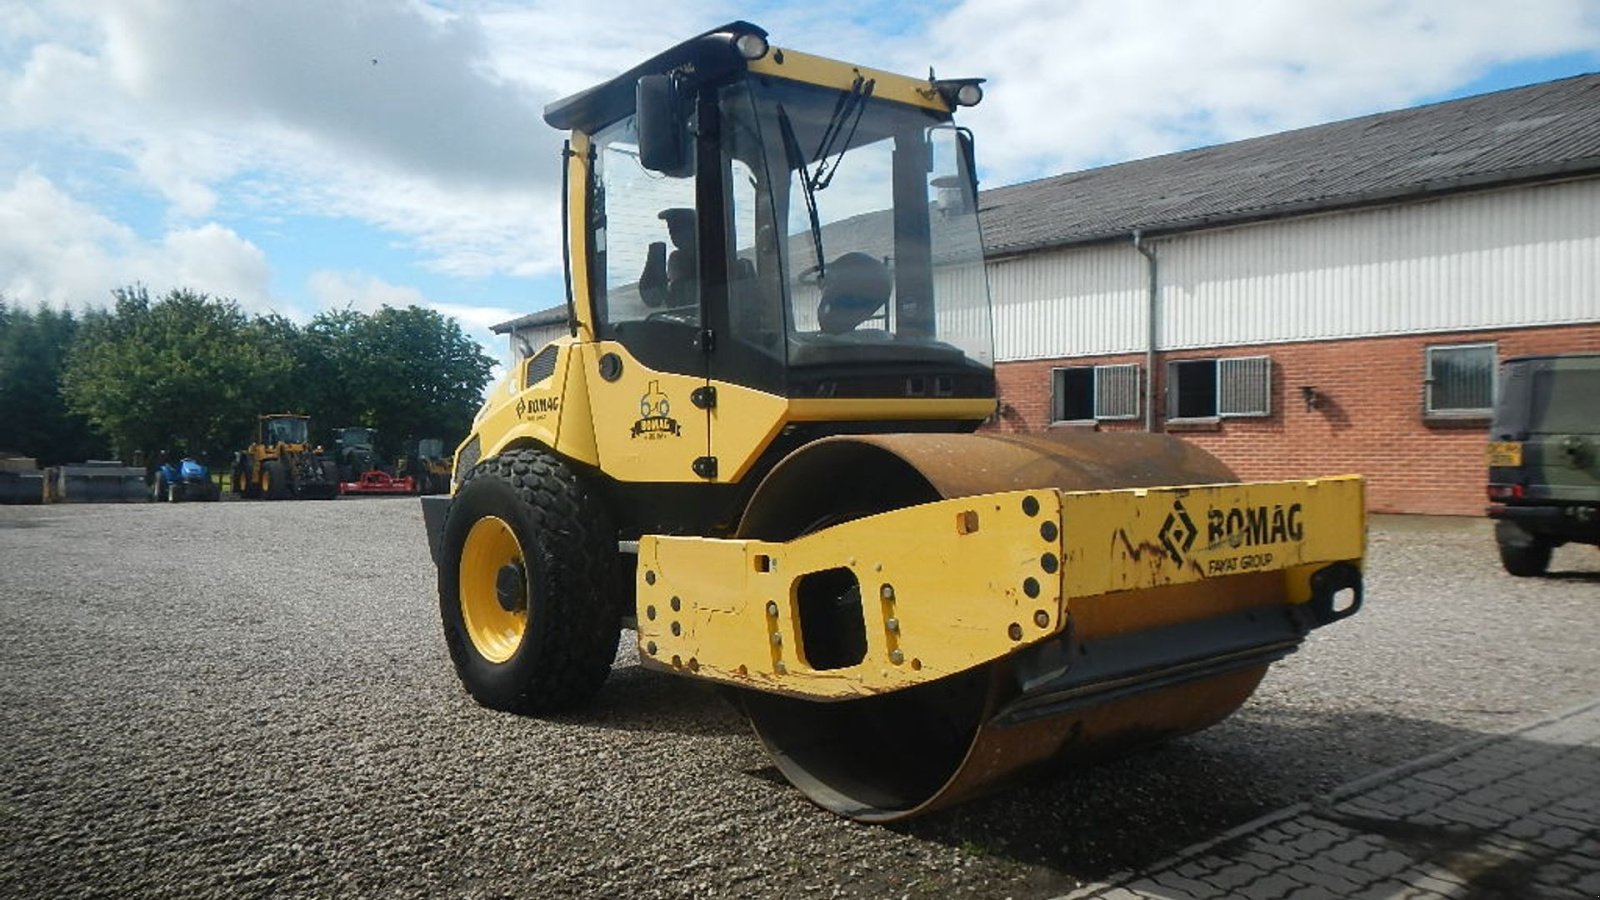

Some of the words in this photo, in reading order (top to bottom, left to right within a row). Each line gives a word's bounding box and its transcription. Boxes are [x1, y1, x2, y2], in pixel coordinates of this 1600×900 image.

[1207, 503, 1303, 549] BOMAG
[1208, 557, 1238, 574] FAYAT
[1241, 553, 1273, 569] GROUP
